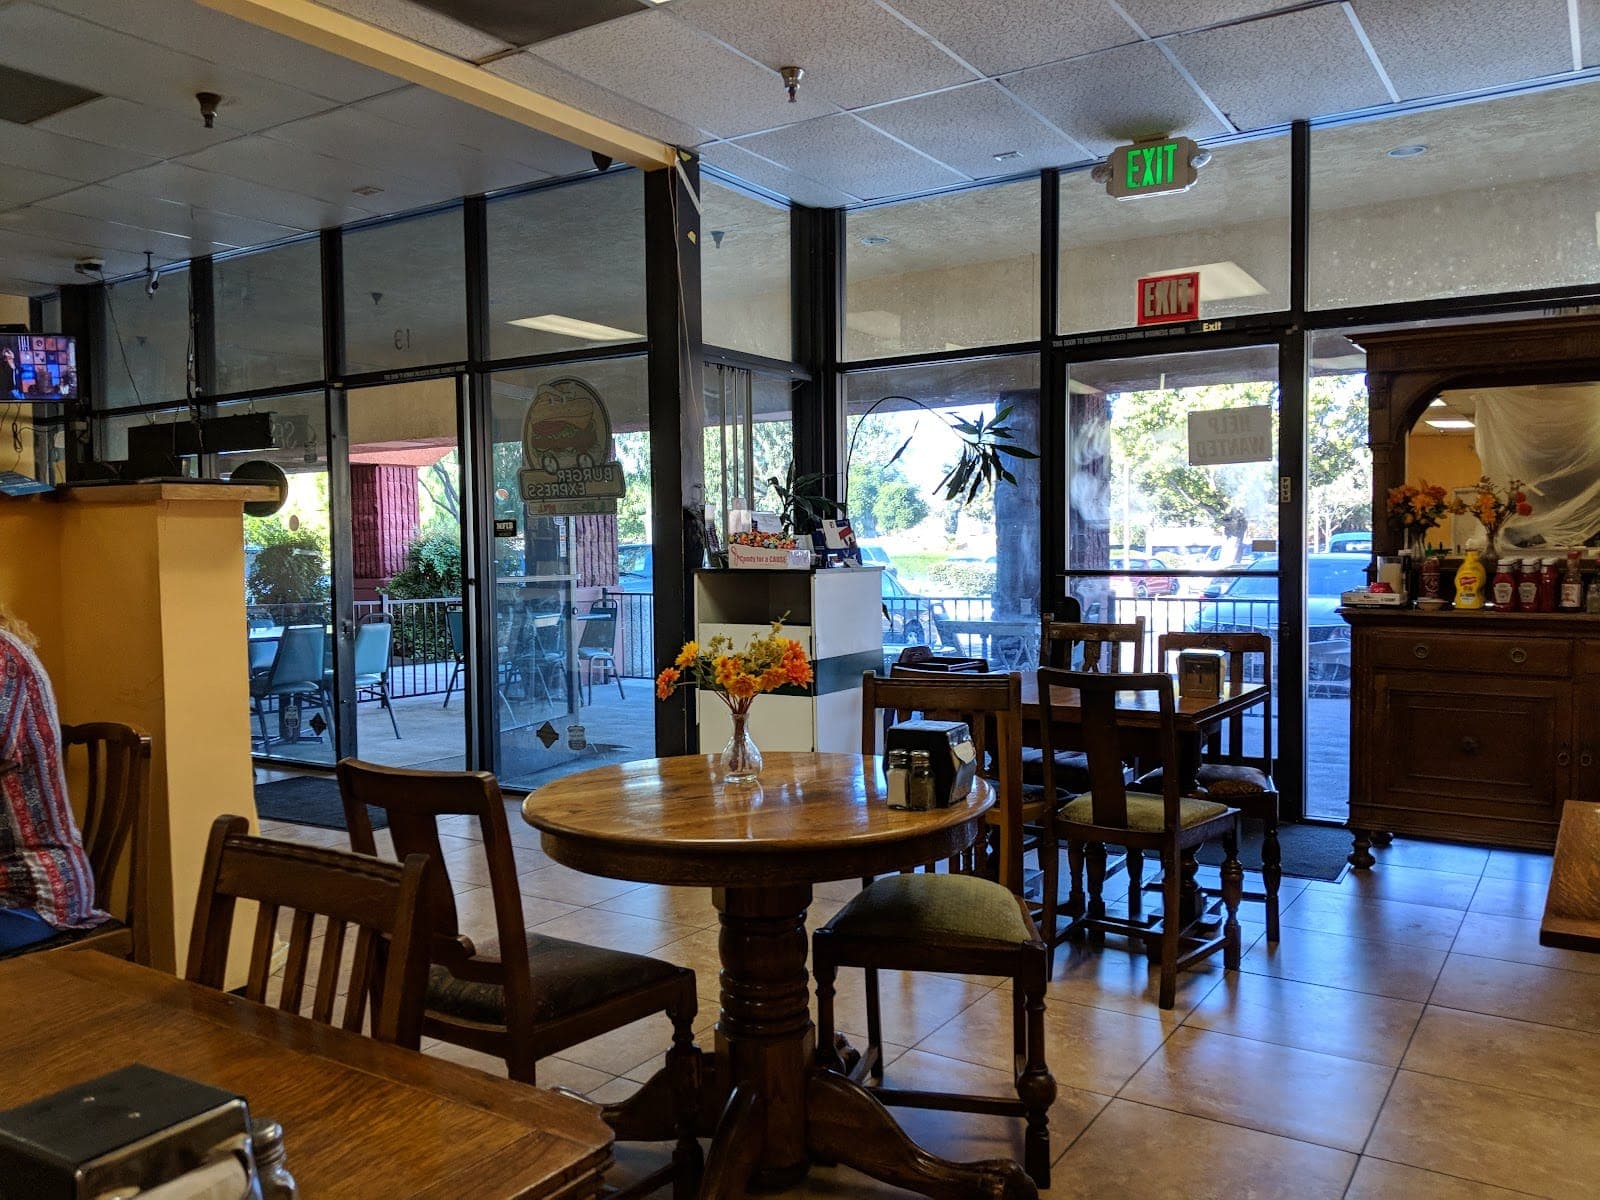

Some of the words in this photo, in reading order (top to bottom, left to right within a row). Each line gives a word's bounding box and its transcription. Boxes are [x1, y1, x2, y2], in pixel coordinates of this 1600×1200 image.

[1126, 144, 1178, 189] EXIT
[1144, 278, 1192, 317] EXIT
[1203, 321, 1222, 332] Exit
